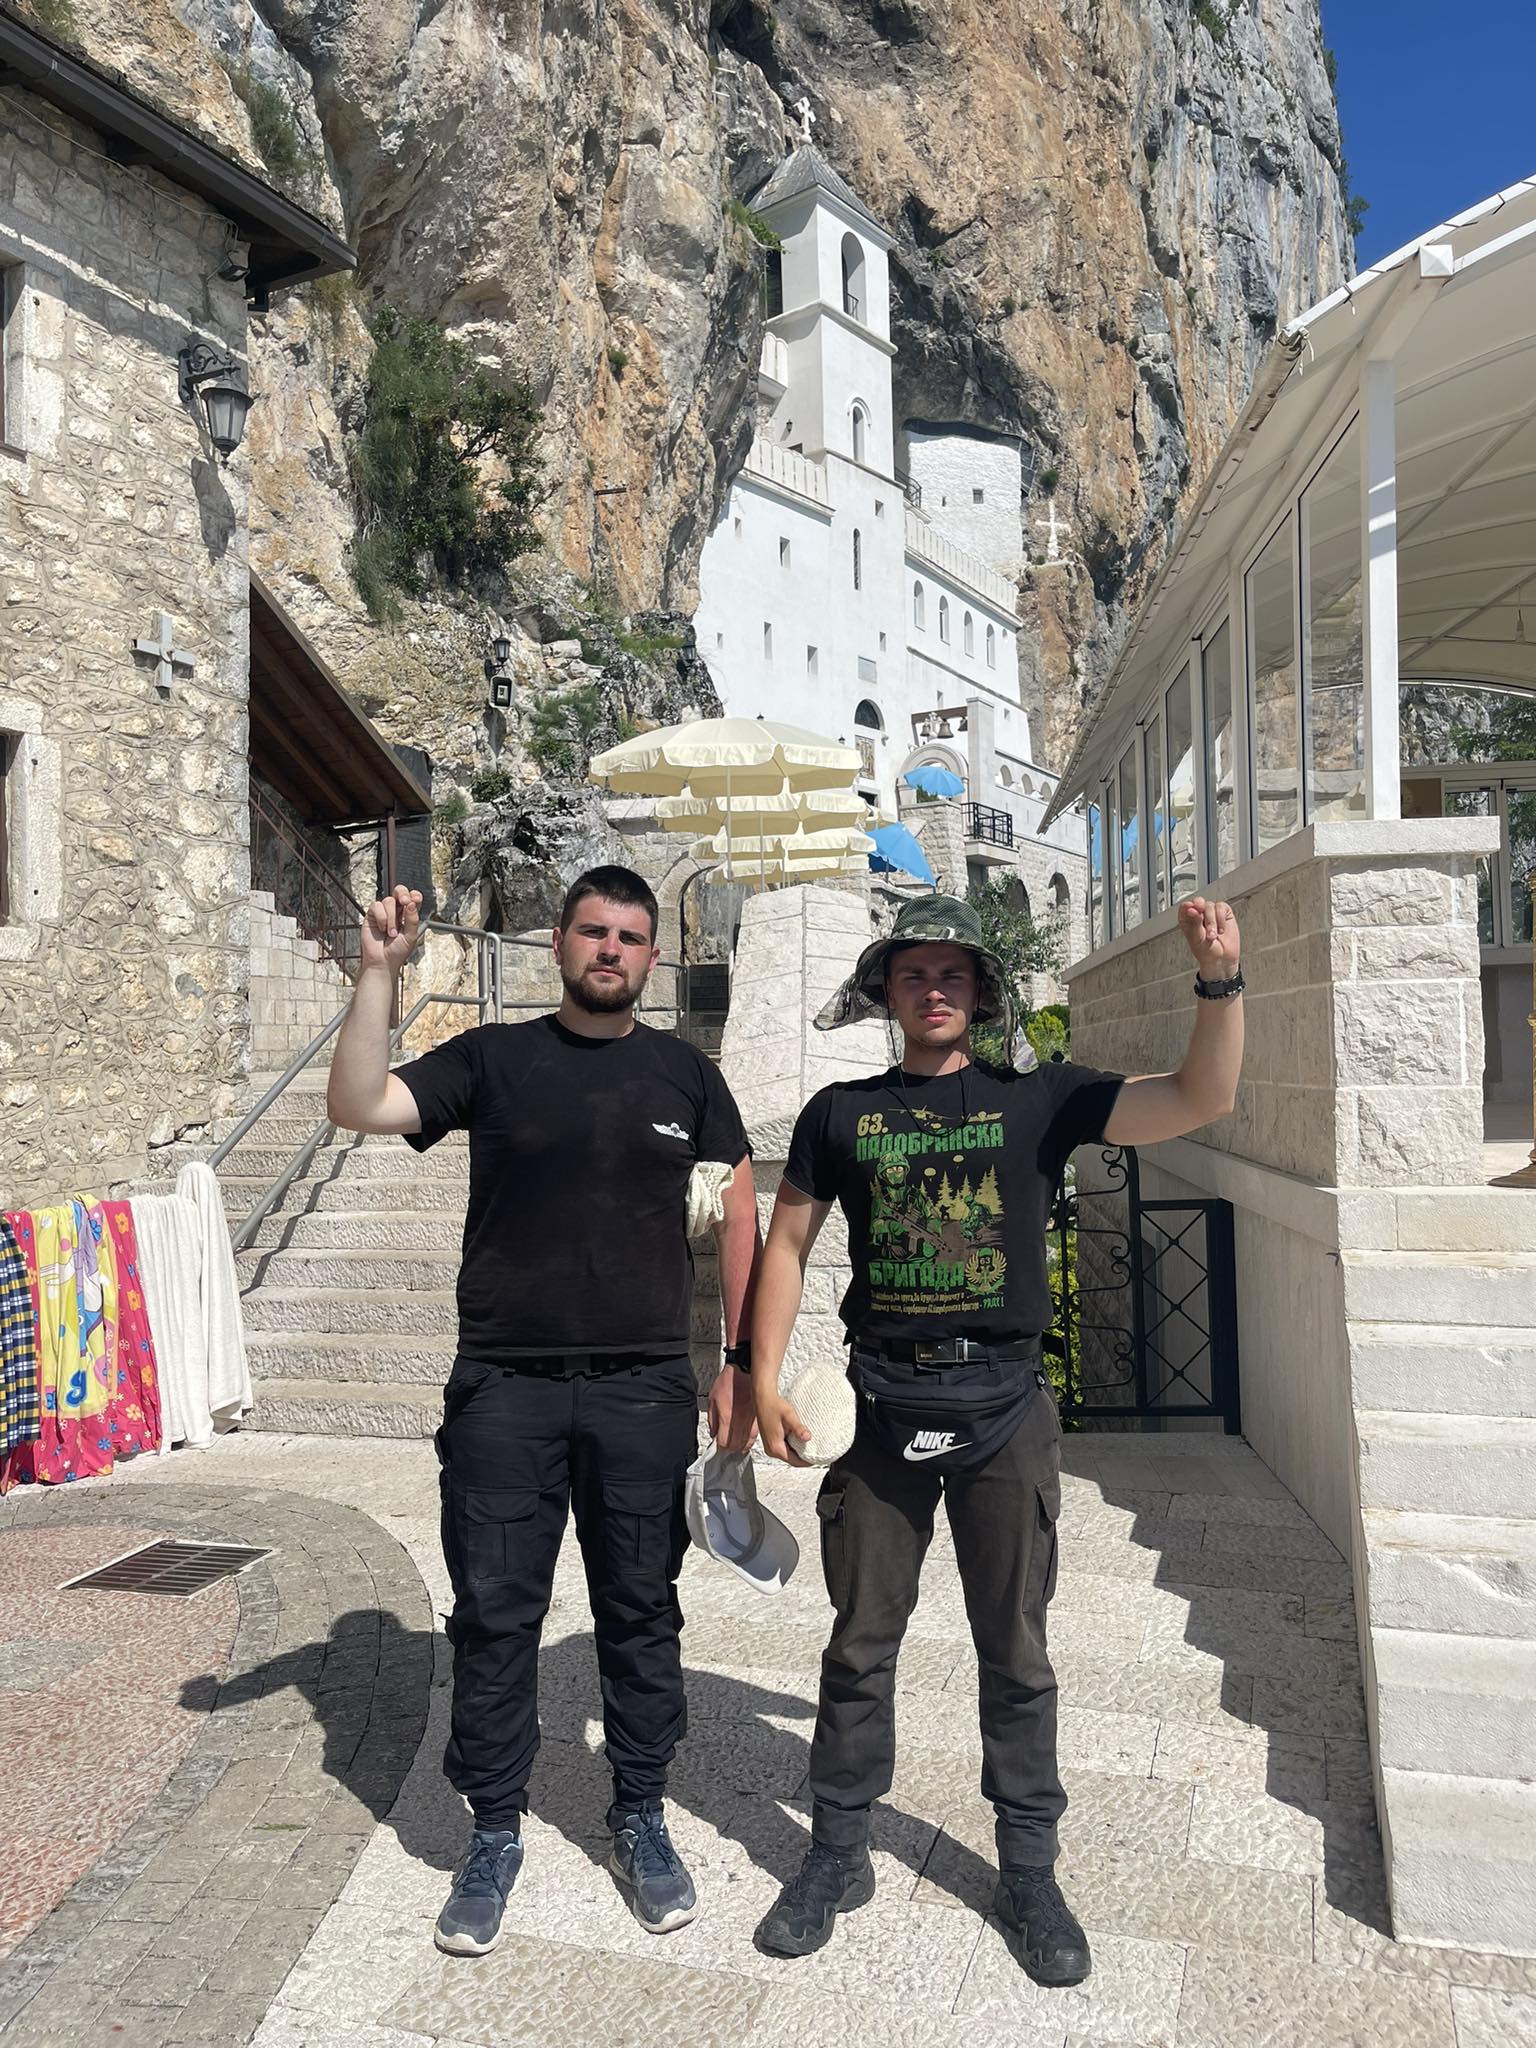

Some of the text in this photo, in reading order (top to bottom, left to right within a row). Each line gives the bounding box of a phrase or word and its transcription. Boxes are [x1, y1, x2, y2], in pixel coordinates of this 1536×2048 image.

[857, 1113, 888, 1136] 63.
[856, 1122, 1004, 1162] ПАДОБРАНСКА
[979, 1256, 992, 1265] 63
[868, 1260, 964, 1291] БРИГАДА
[912, 1430, 955, 1449] NIKE
